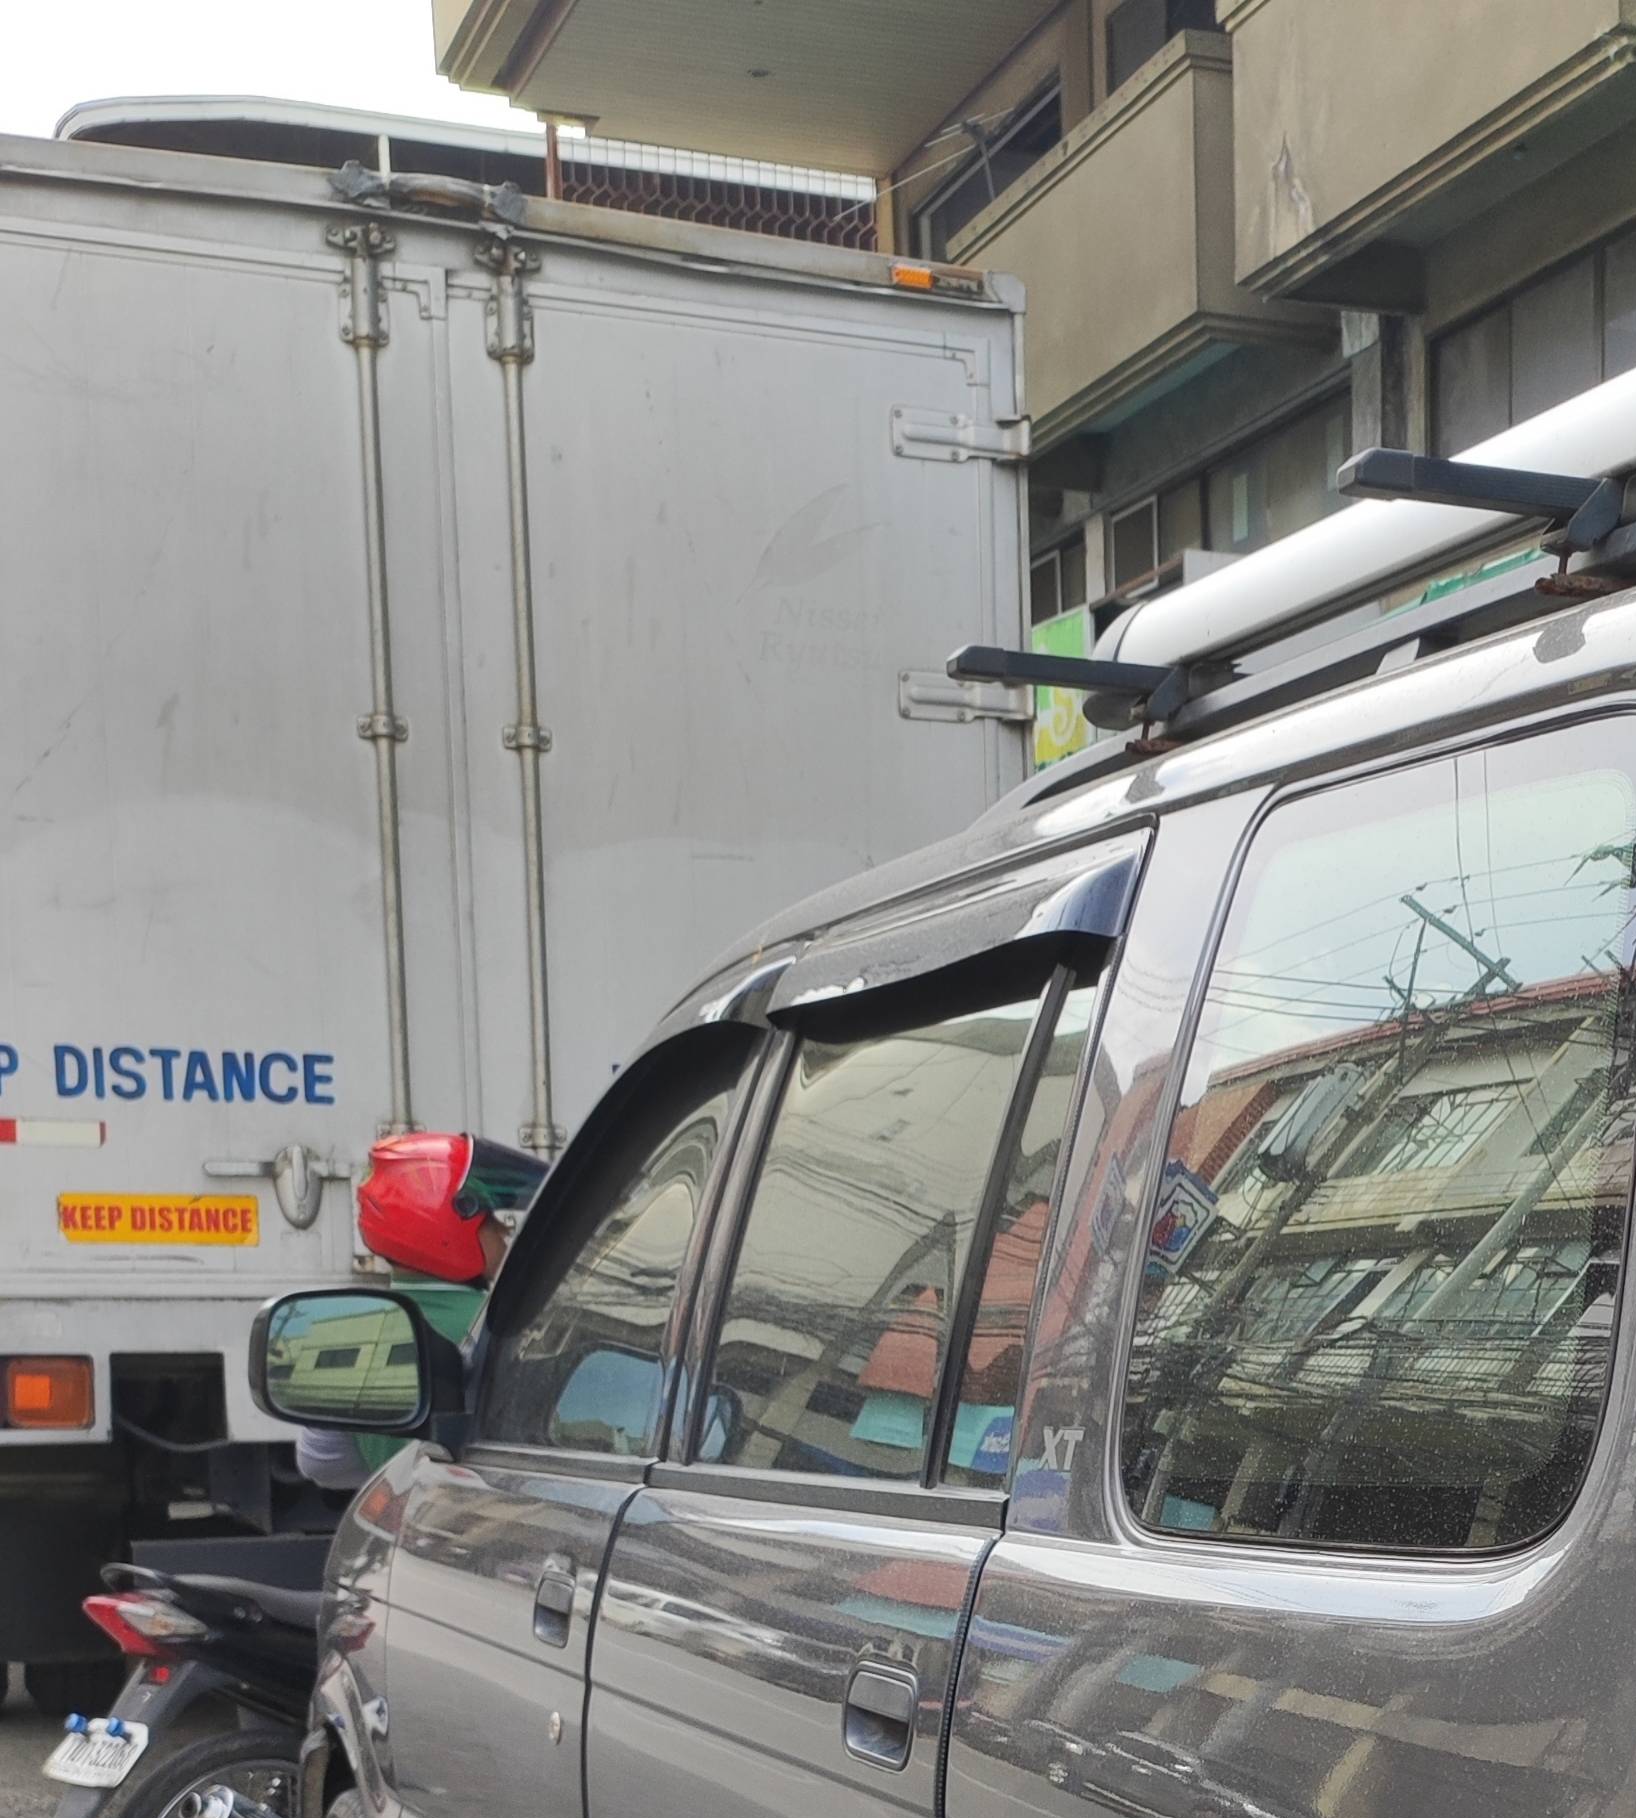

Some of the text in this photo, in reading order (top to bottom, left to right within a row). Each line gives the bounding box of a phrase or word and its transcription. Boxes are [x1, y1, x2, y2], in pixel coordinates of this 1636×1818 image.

[54, 1044, 335, 1104] DISTANCE
[61, 1205, 253, 1234] KEEP DISTANCE
[1038, 1425, 1086, 1472] XT
